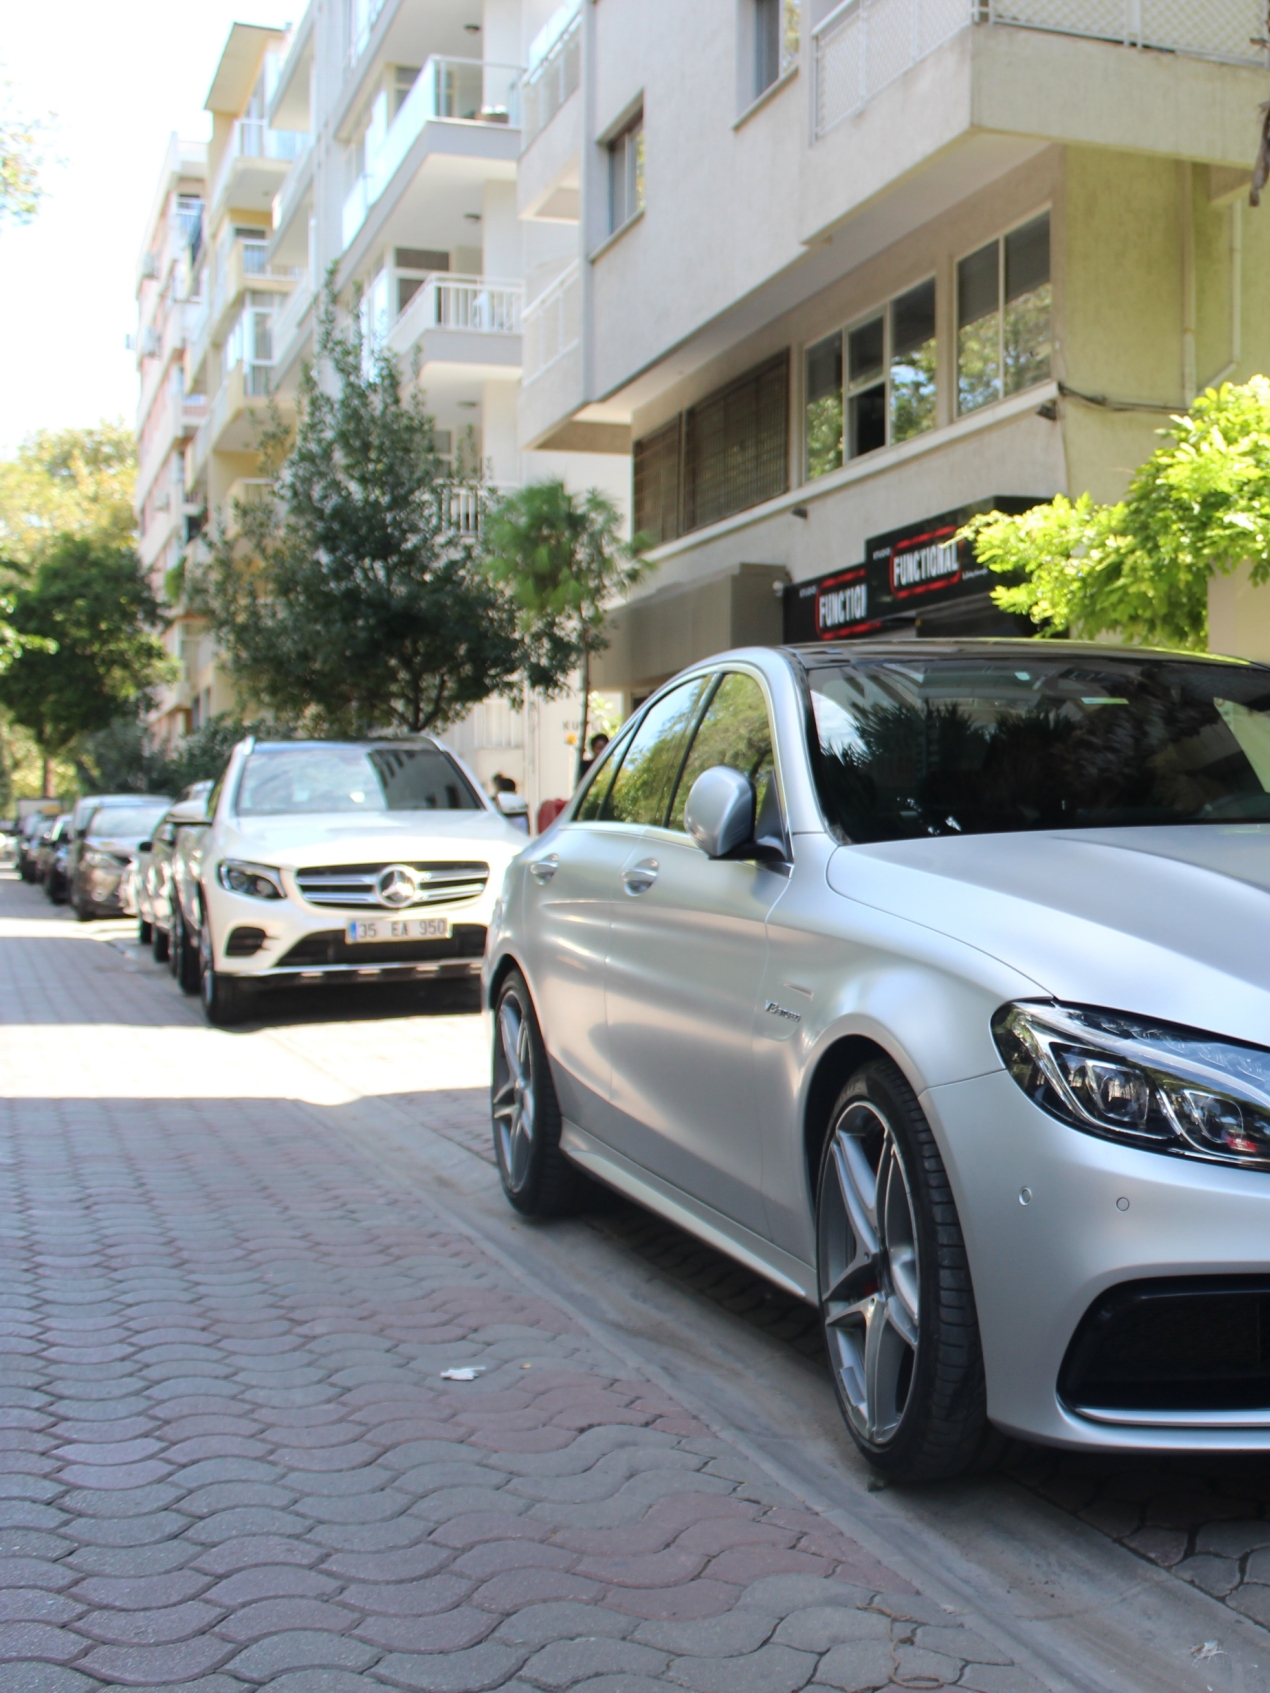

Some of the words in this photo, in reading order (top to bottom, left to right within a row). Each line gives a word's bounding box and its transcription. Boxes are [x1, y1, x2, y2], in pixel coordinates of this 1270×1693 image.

[894, 542, 959, 587] FUNCTIONAL
[359, 924, 377, 938] 35
[391, 922, 408, 936] EA
[419, 919, 446, 935] 950
